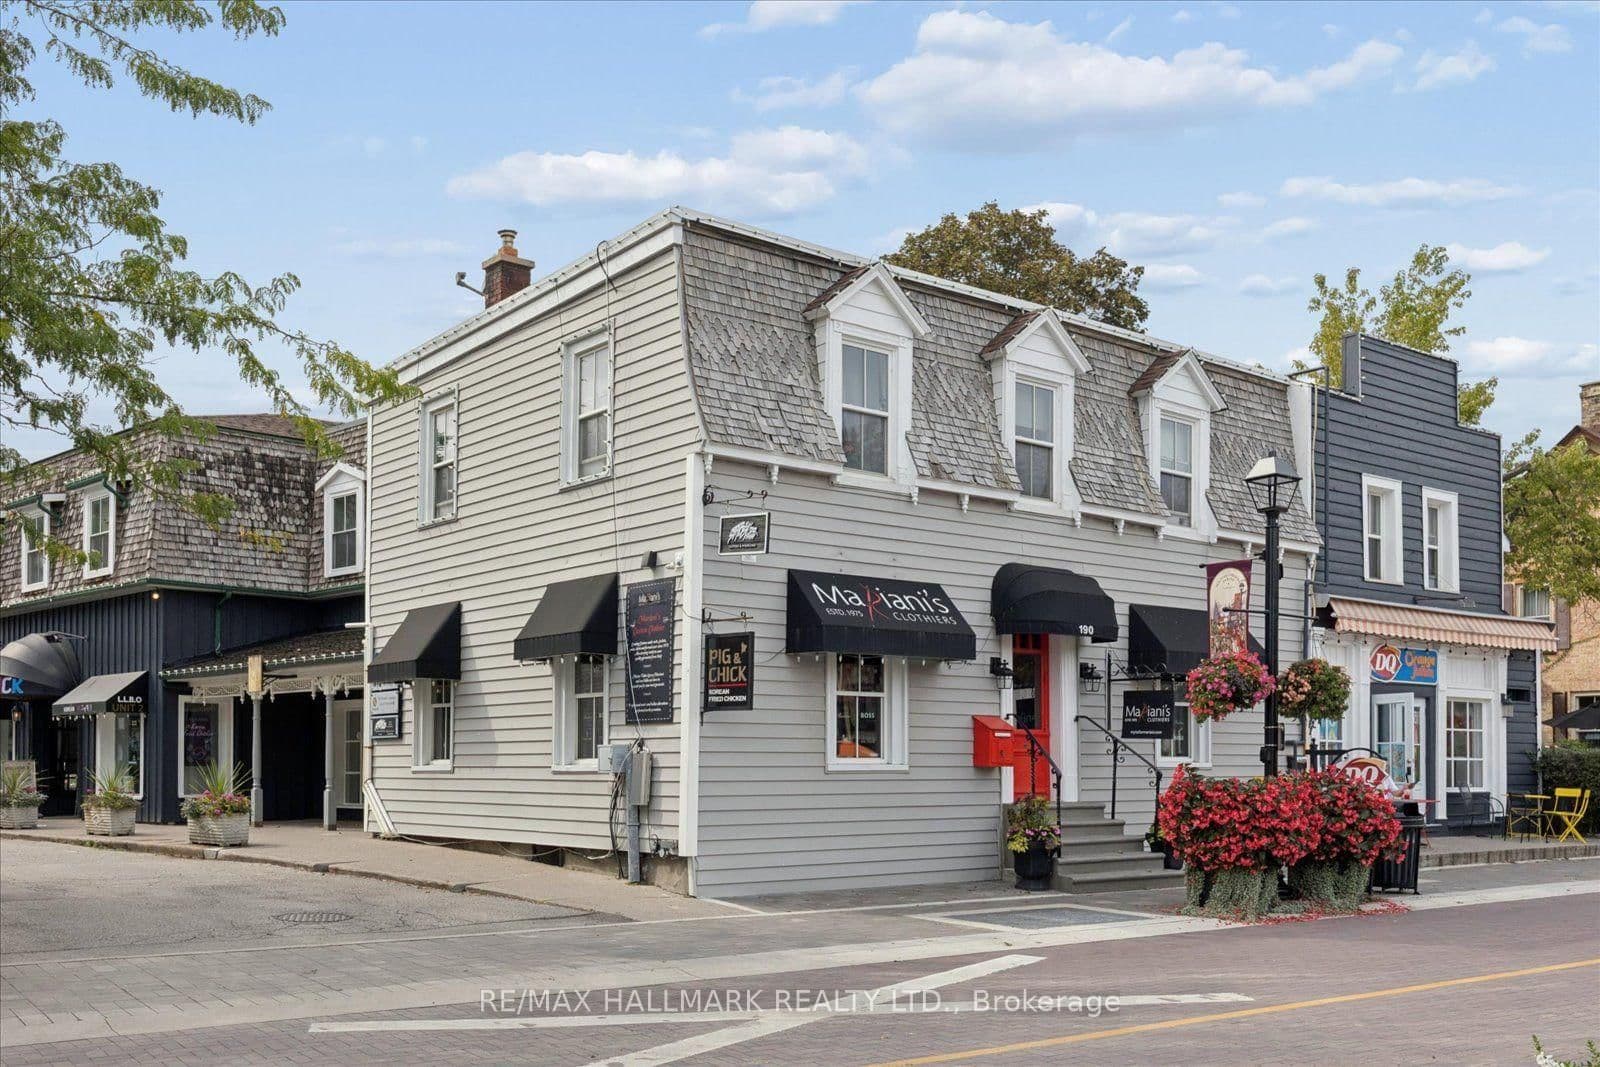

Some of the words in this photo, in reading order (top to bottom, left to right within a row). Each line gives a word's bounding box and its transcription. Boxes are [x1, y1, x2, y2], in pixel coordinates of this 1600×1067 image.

[892, 611, 957, 625] CLOTHIERS
[1079, 624, 1094, 635] 190
[709, 648, 731, 666] PIG
[733, 652, 741, 664] &
[1375, 653, 1397, 674] DQ
[708, 666, 747, 682] CHICK
[112, 704, 136, 712] UNIT
[860, 711, 875, 719] BOSS
